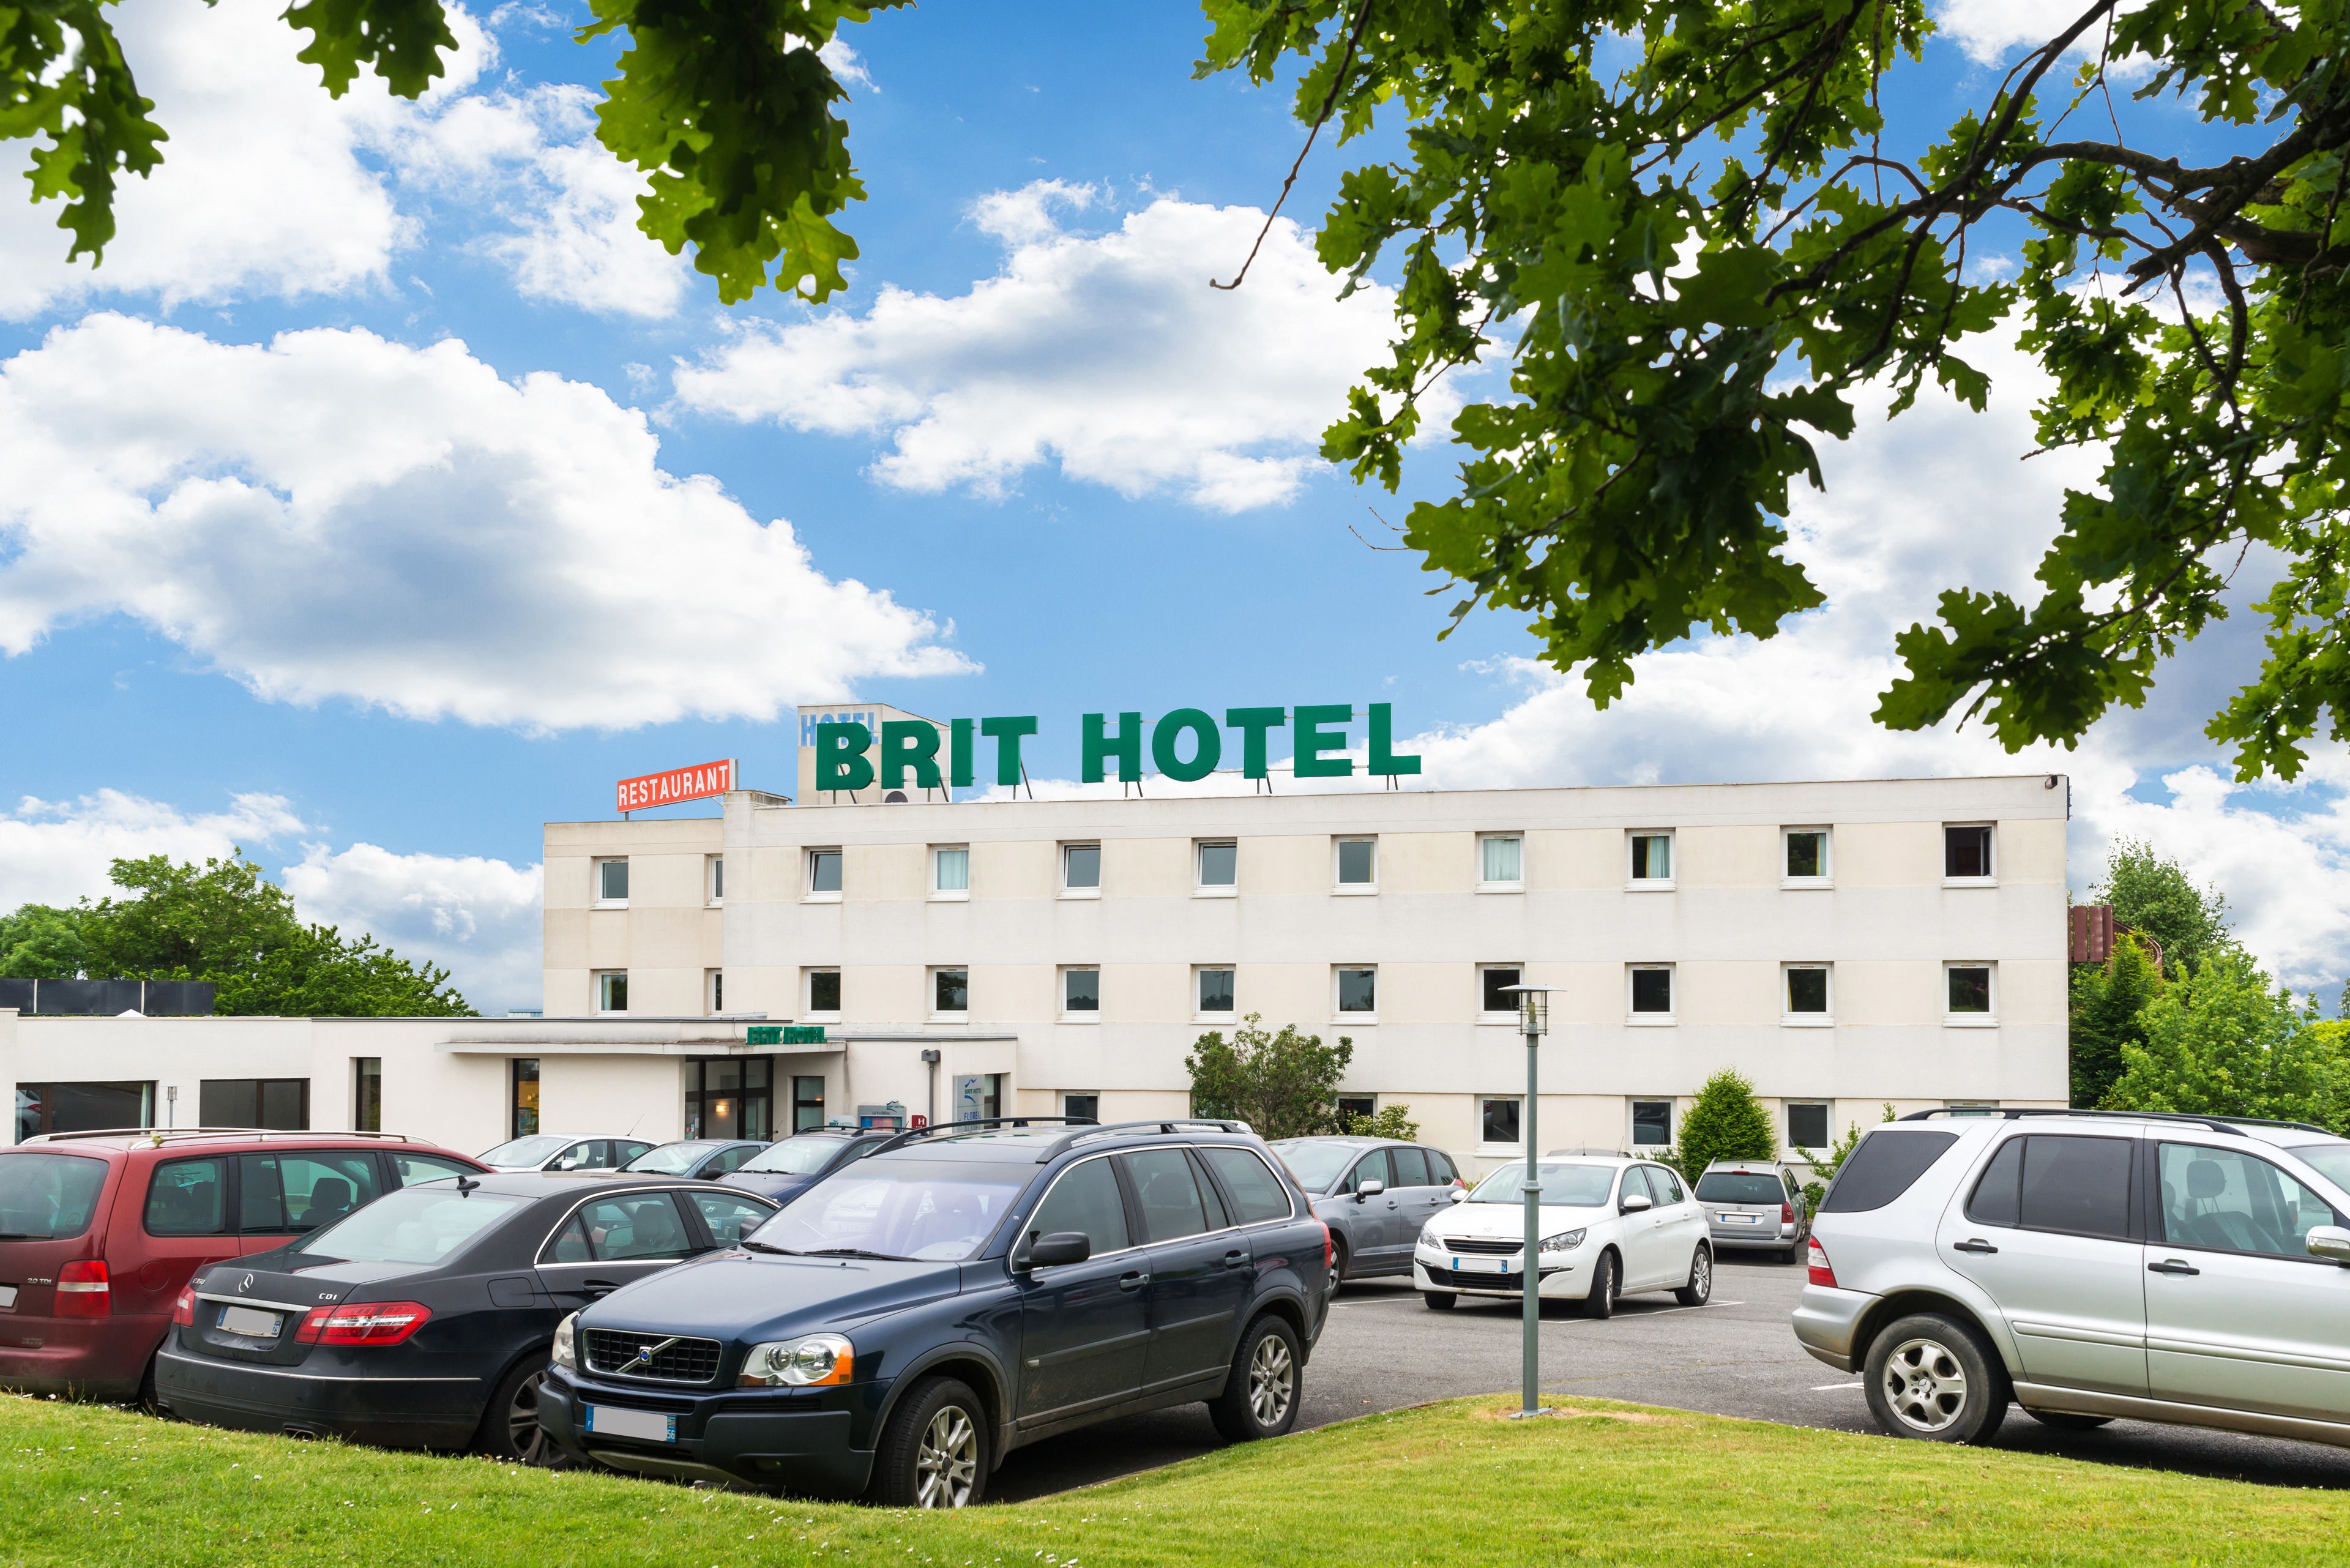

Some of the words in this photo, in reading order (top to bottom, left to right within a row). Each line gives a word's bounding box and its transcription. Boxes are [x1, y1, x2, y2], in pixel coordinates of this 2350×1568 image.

[816, 716, 1038, 791] BRIT
[1082, 703, 1421, 783] HOTEL
[619, 765, 728, 807] RESTAURANT
[667, 1429, 676, 1439] 56
